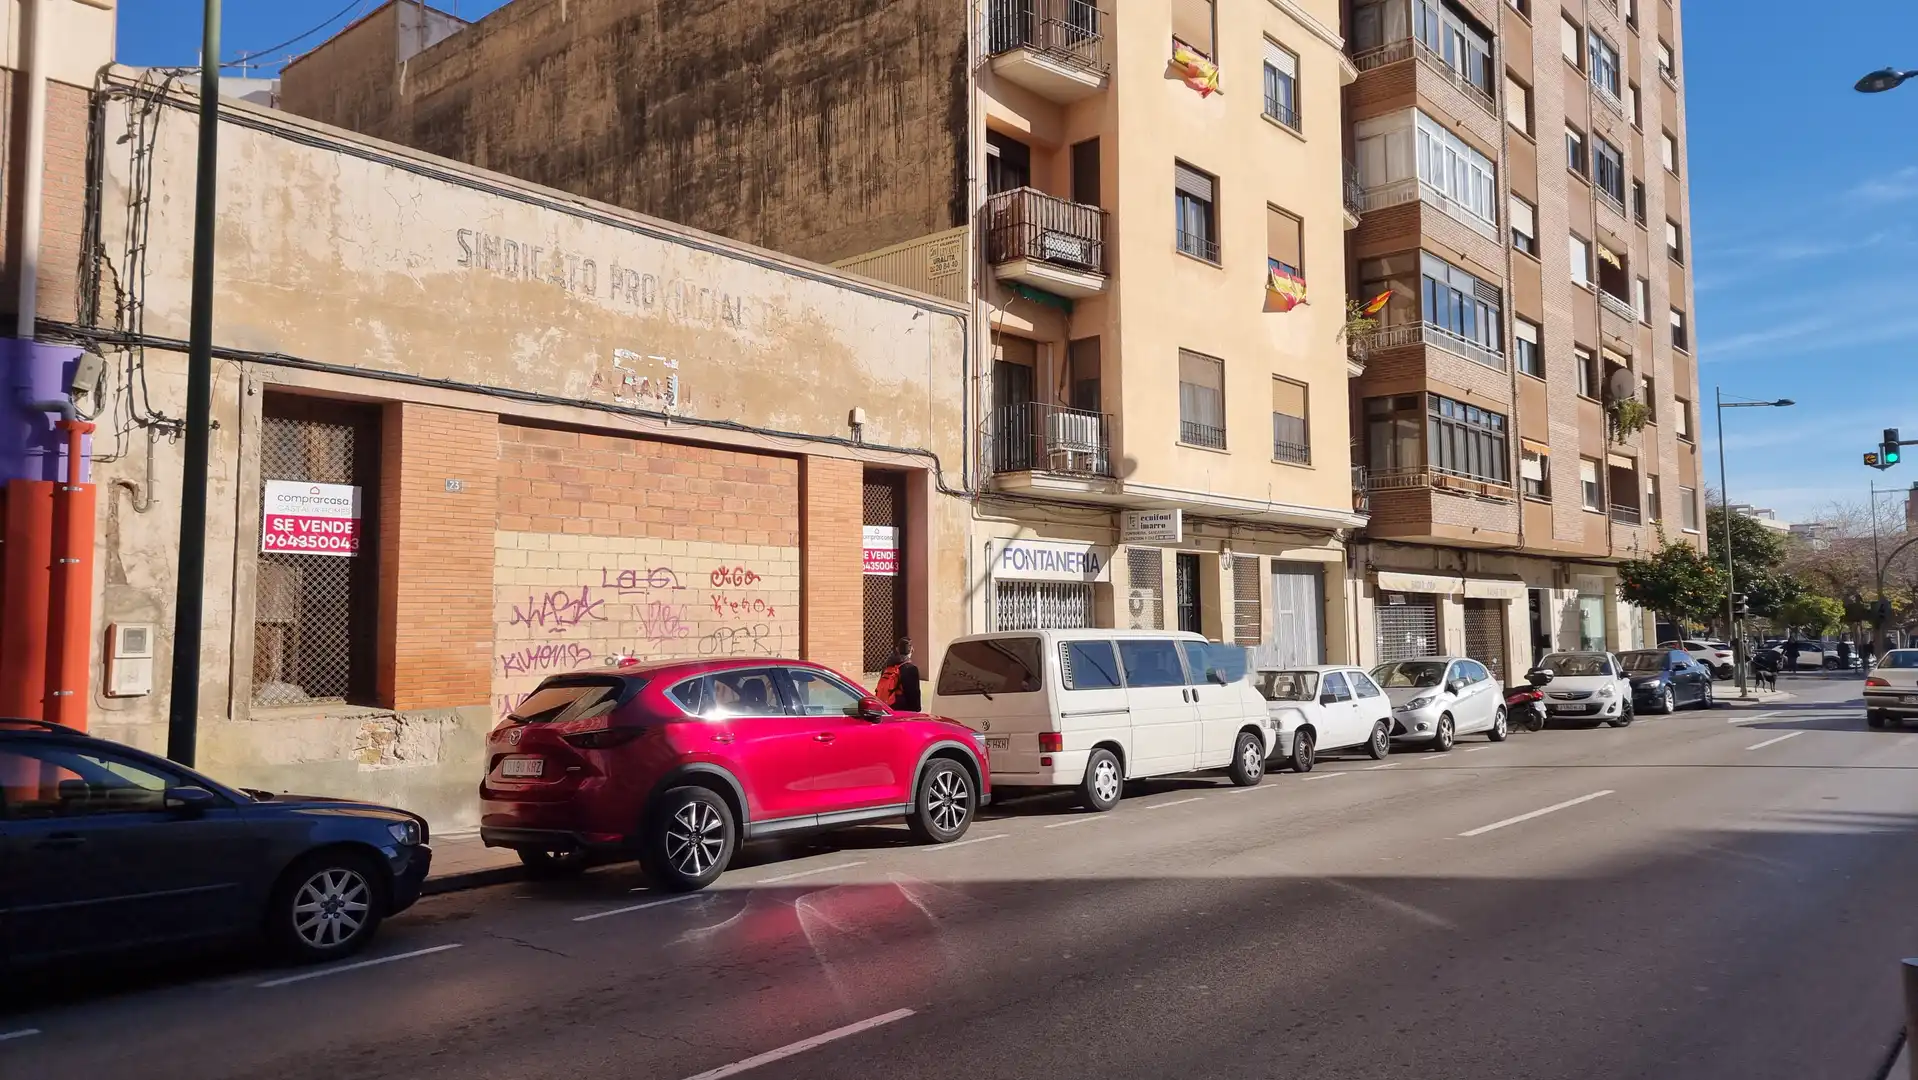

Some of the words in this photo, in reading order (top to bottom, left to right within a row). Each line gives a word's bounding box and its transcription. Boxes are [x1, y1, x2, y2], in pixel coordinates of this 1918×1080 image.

[449, 480, 460, 490] 23
[277, 494, 349, 506] comprarcasa
[273, 517, 295, 532] SE
[298, 519, 354, 535] VENDE
[265, 533, 360, 550] 964350043
[870, 550, 897, 561] VENDE
[1003, 547, 1100, 574] FONTANERIA
[863, 561, 899, 571] 64350043
